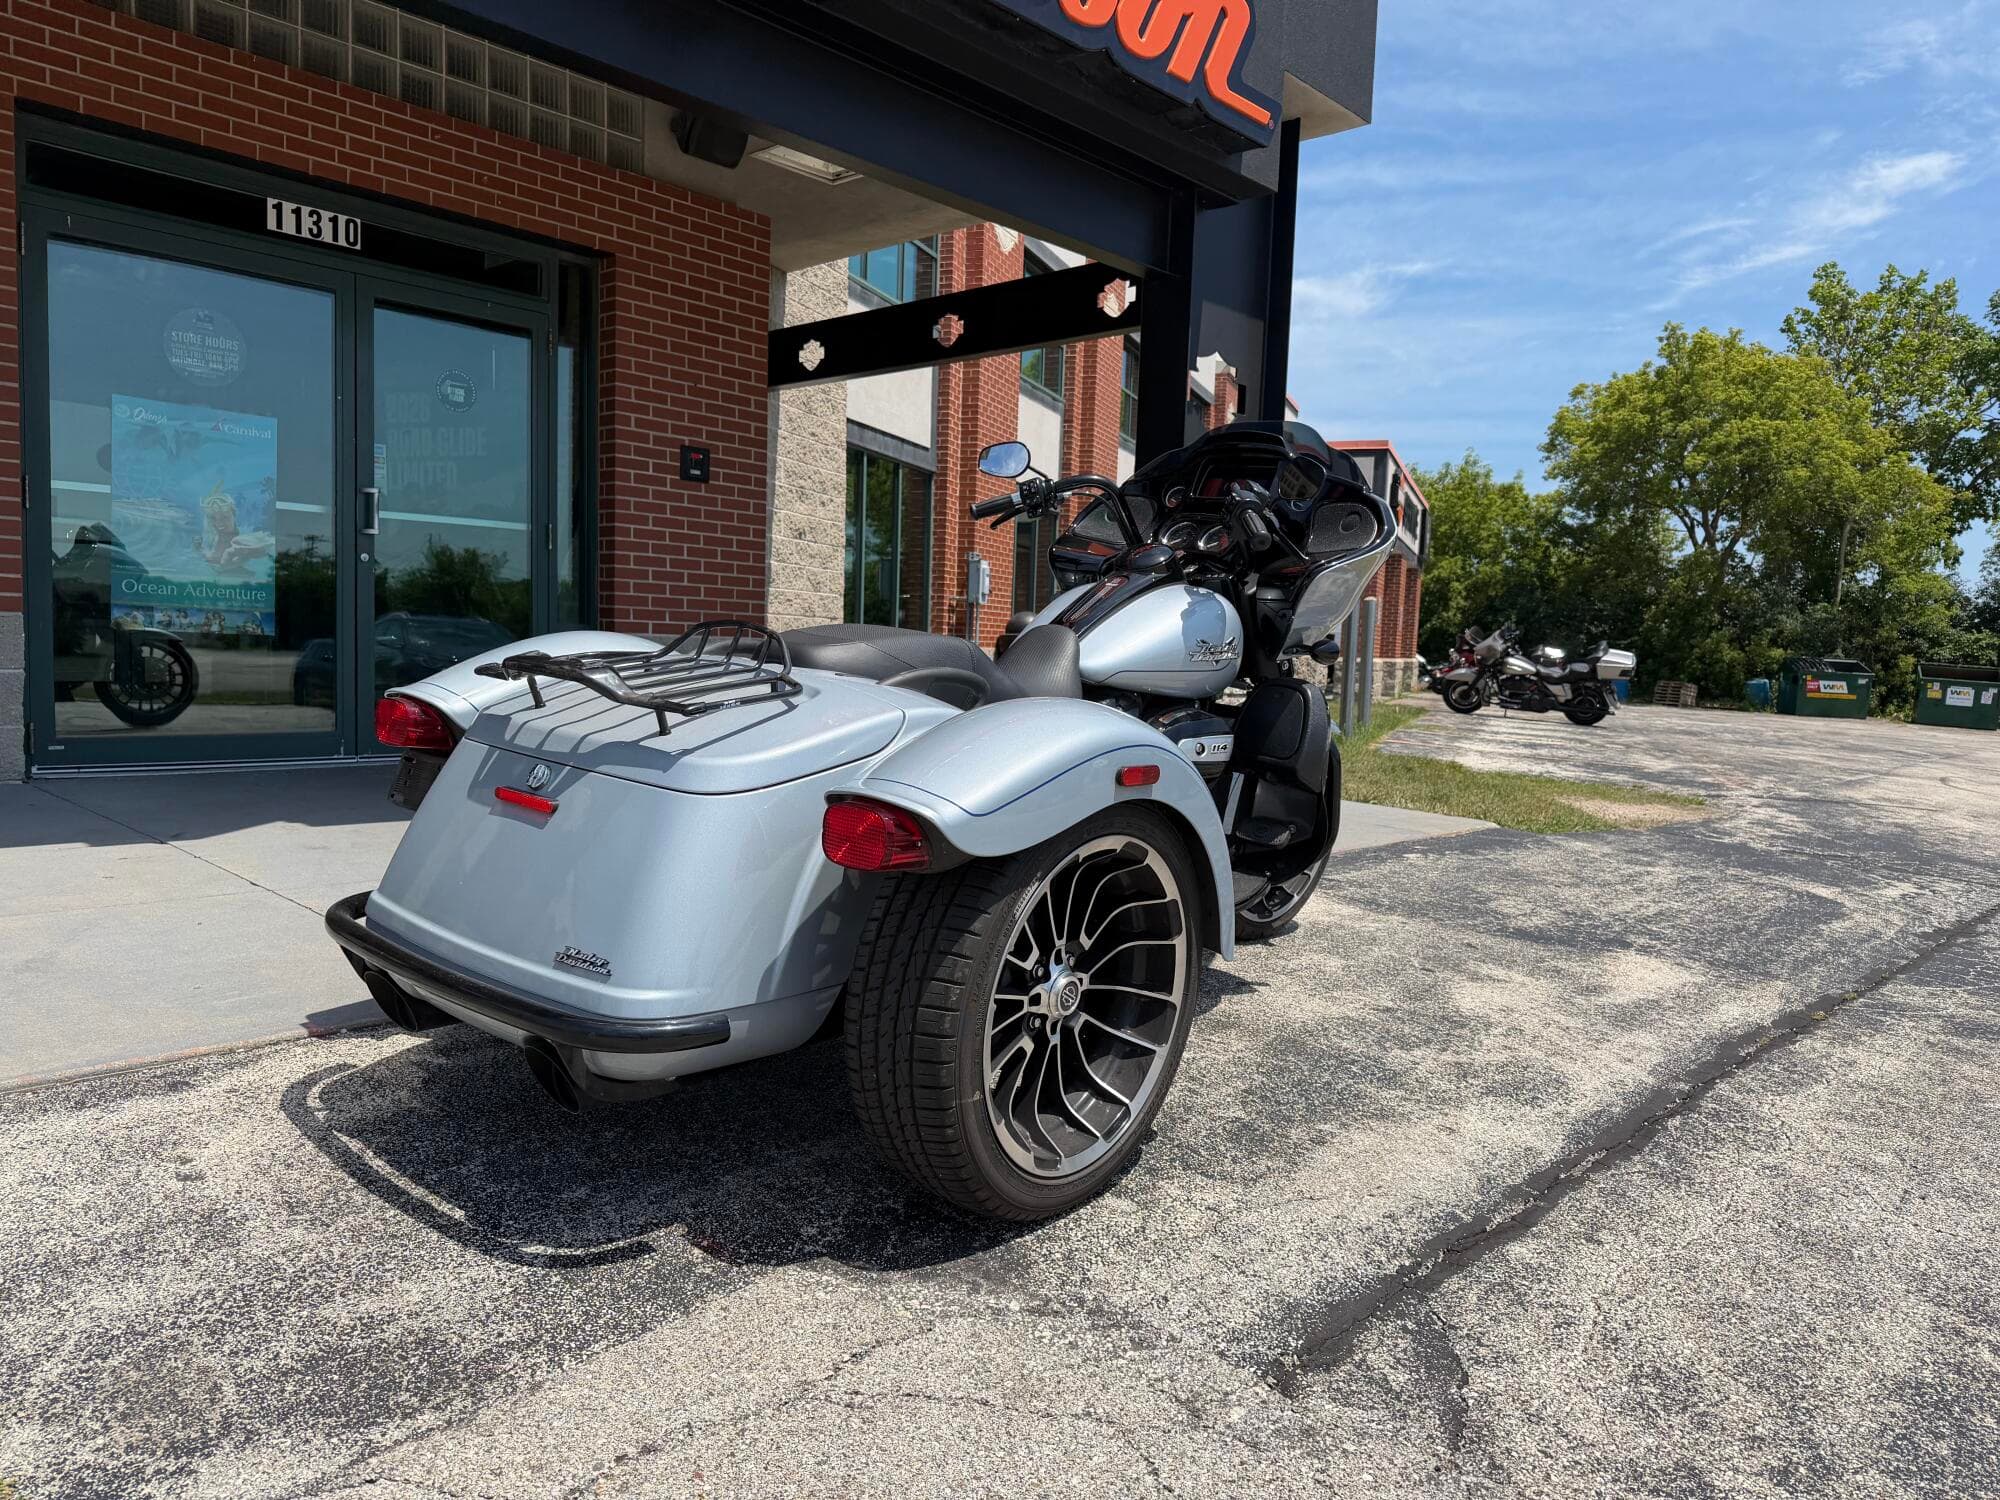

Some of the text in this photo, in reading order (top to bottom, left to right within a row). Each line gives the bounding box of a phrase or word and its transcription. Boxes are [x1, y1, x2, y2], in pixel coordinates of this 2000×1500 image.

[272, 201, 359, 248] 11310
[171, 331, 203, 345] STORE
[205, 336, 240, 351] HOURS
[225, 424, 272, 440] Carnival
[121, 579, 267, 602] Ocean Adventure
[1211, 743, 1229, 752] 114
[555, 953, 613, 976] Davidson
